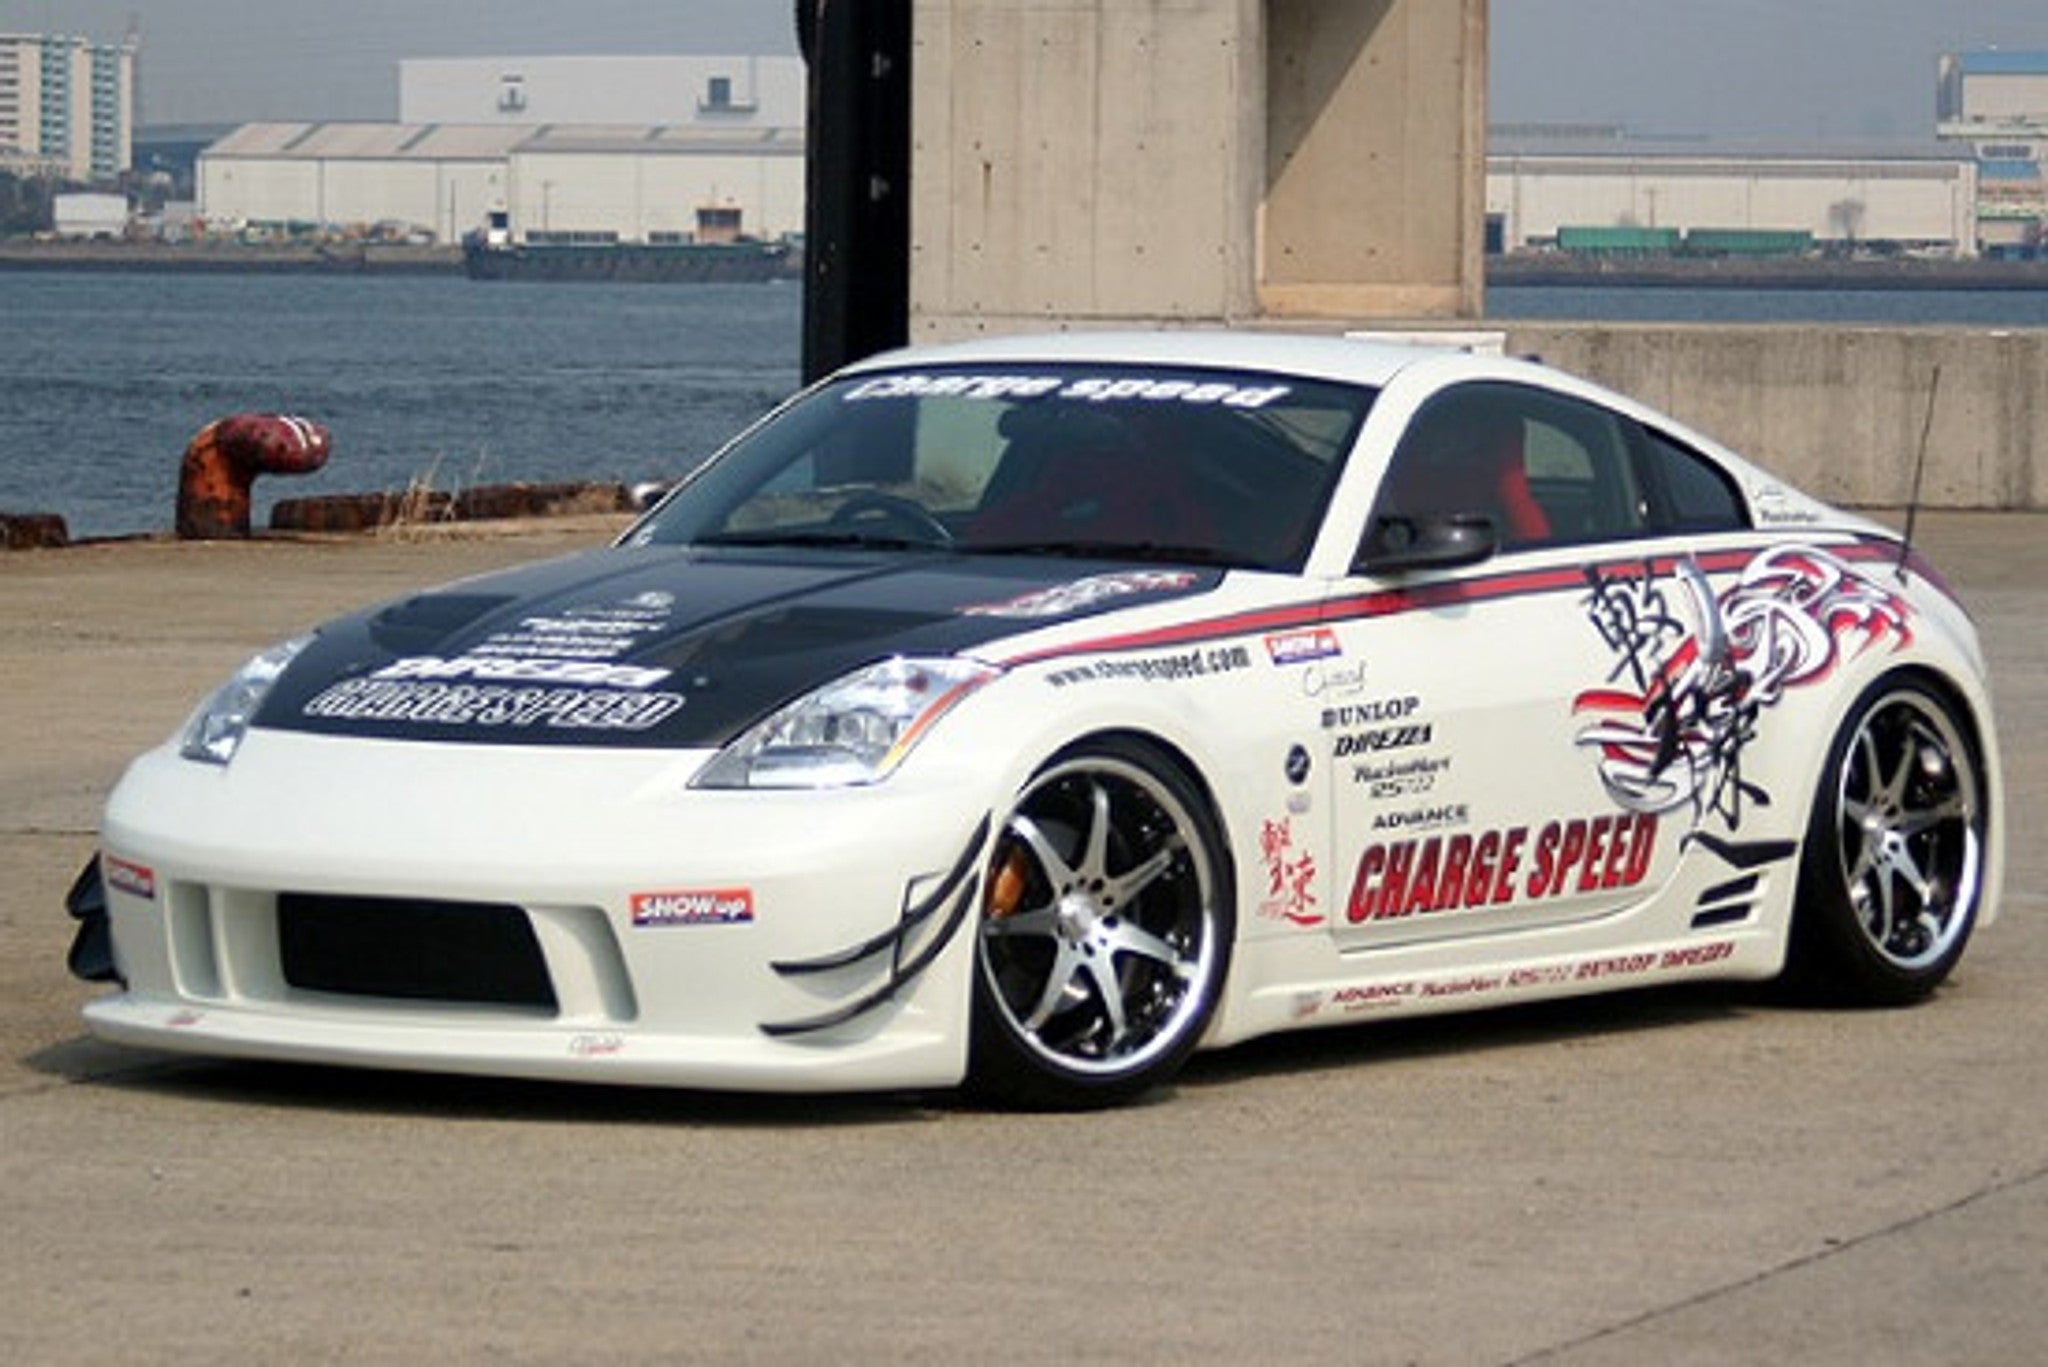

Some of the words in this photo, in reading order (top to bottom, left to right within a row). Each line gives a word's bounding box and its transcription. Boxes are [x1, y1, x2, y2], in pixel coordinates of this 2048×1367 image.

[1320, 696, 1420, 728] DUNLOP
[1371, 804, 1470, 830] ADVANCE
[1347, 825, 1529, 925] CHARGE
[1526, 811, 1659, 899] SPEED
[637, 894, 717, 919] SHOW
[716, 899, 747, 919] up
